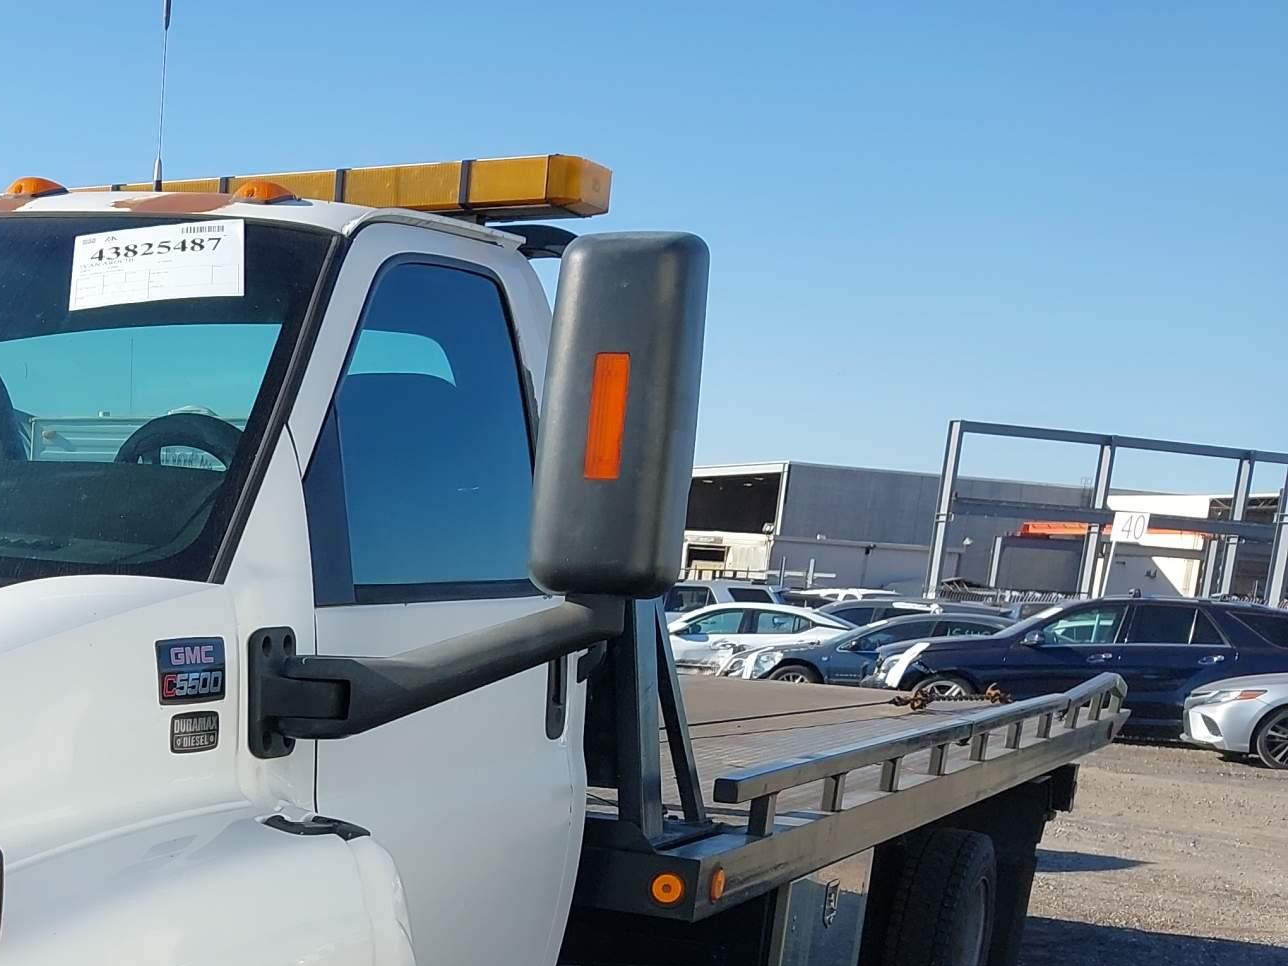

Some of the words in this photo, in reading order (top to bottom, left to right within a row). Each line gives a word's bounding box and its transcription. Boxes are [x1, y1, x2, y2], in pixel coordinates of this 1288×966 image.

[90, 236, 223, 262] 43825487
[1121, 514, 1146, 540] 40
[170, 645, 214, 666] GMC
[163, 671, 223, 697] C5500
[174, 716, 217, 733] DURAMAX
[182, 735, 209, 747] DIESEL
